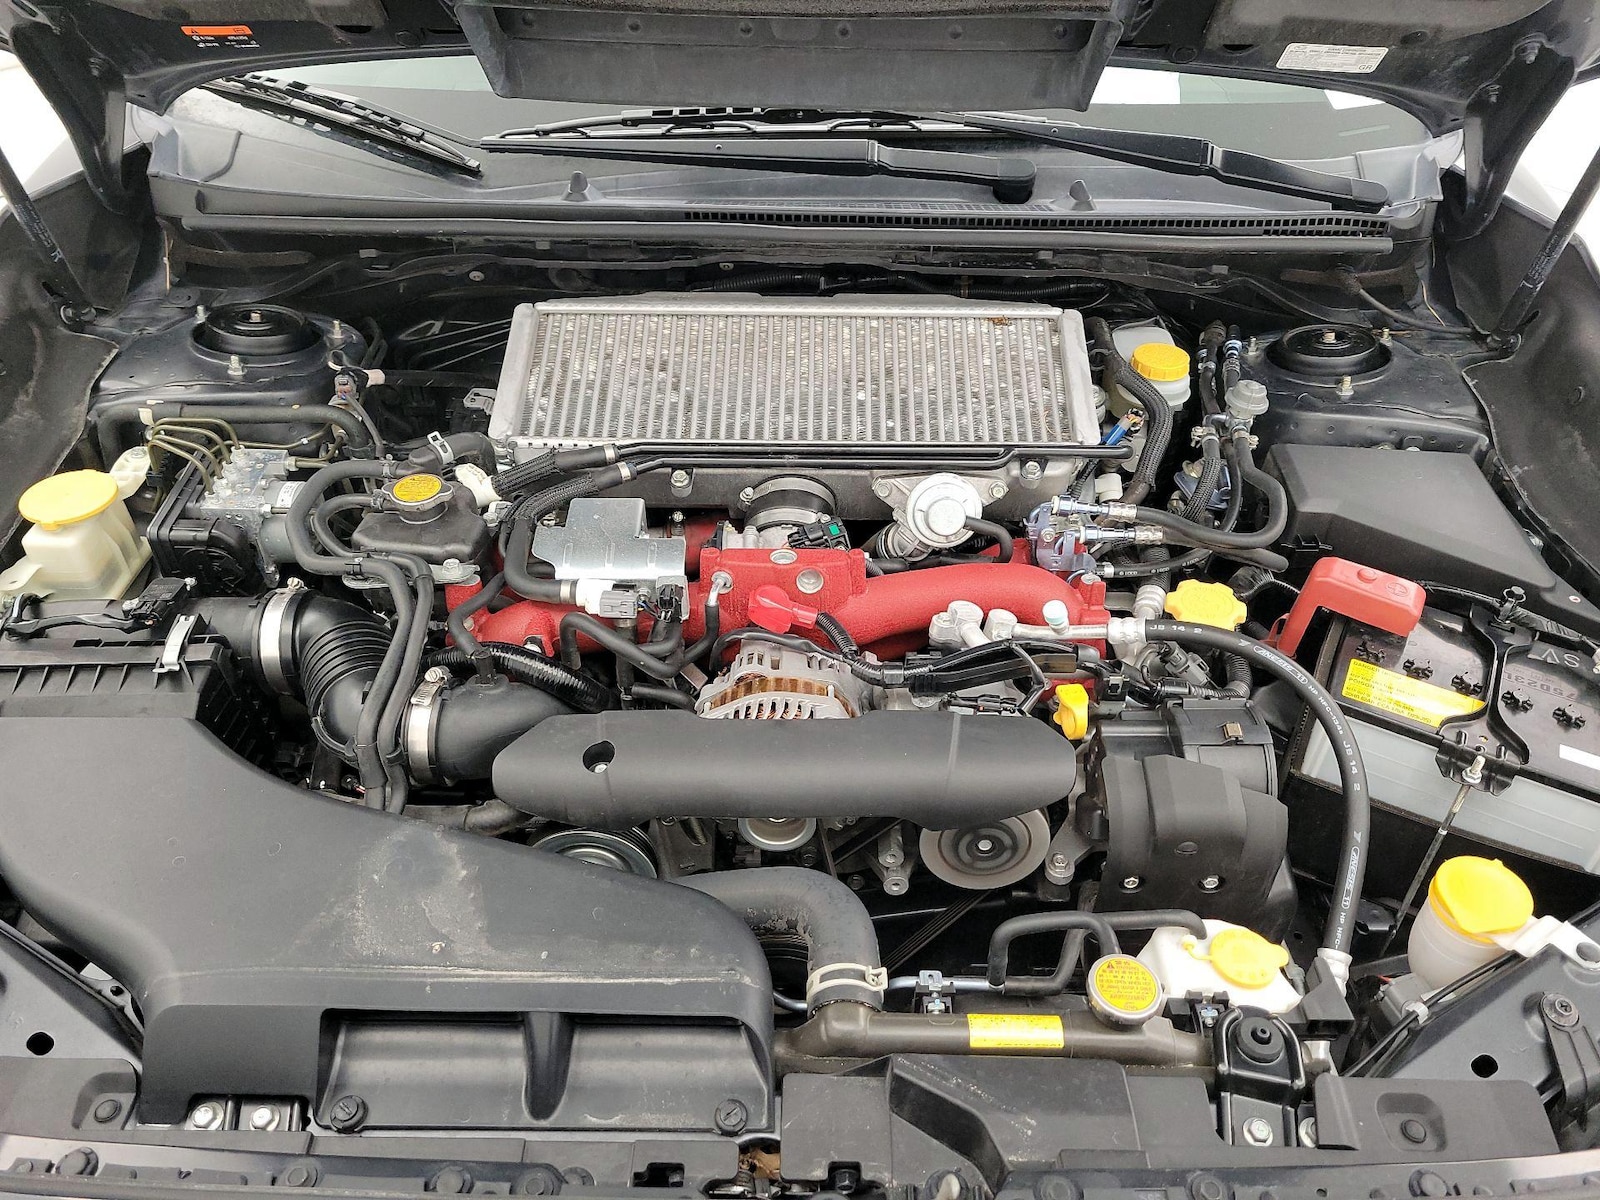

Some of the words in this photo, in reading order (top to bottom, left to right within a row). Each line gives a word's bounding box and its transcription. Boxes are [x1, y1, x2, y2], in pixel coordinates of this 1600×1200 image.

[51, 247, 64, 263] R
[1541, 647, 1581, 669] SV
[1343, 740, 1354, 756] JB
[1350, 760, 1359, 774] 14
[1353, 782, 1361, 791] 2
